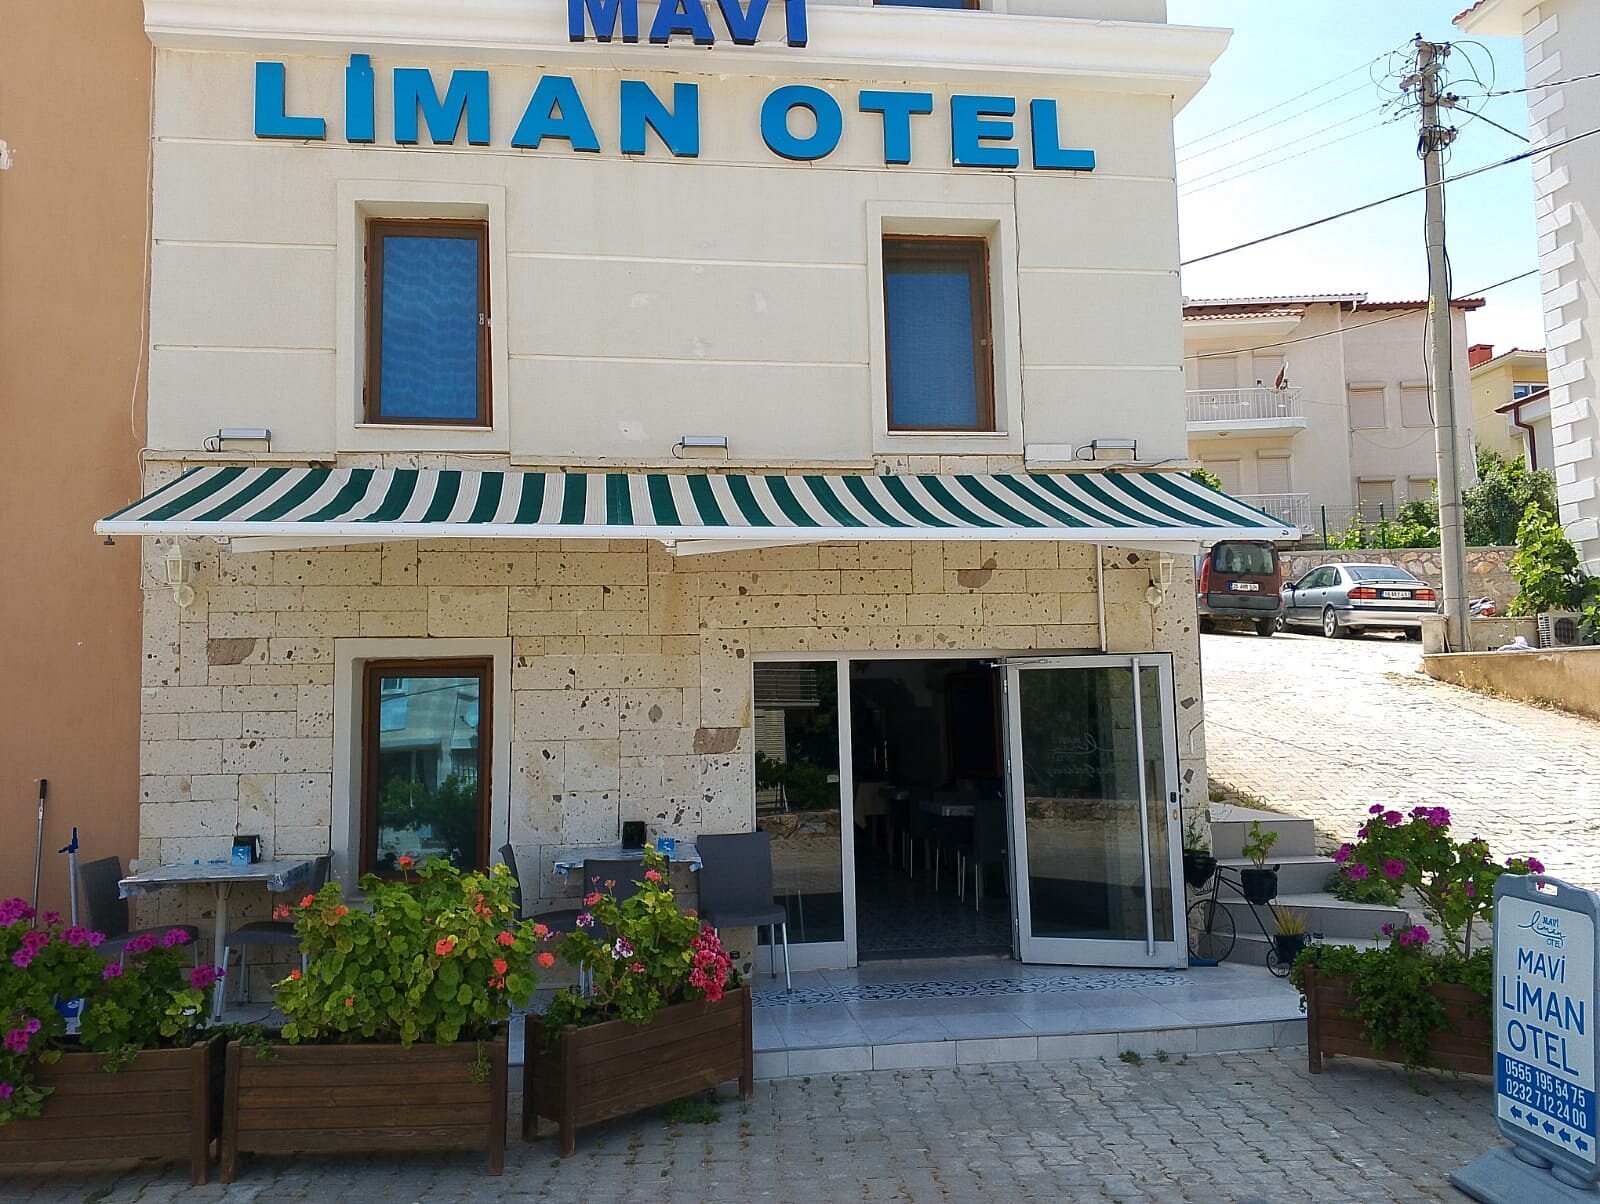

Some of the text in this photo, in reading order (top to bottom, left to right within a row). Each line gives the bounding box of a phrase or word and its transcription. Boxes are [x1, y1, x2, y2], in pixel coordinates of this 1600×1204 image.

[254, 53, 1096, 171] LİMAN OTEL
[1517, 947, 1567, 985] MAVİ
[1502, 975, 1585, 1036] LİMAN
[1507, 1019, 1580, 1077] OTEL
[1505, 1058, 1586, 1108] 0555 195 54 75
[1506, 1078, 1587, 1130] 0232 712 24 00
